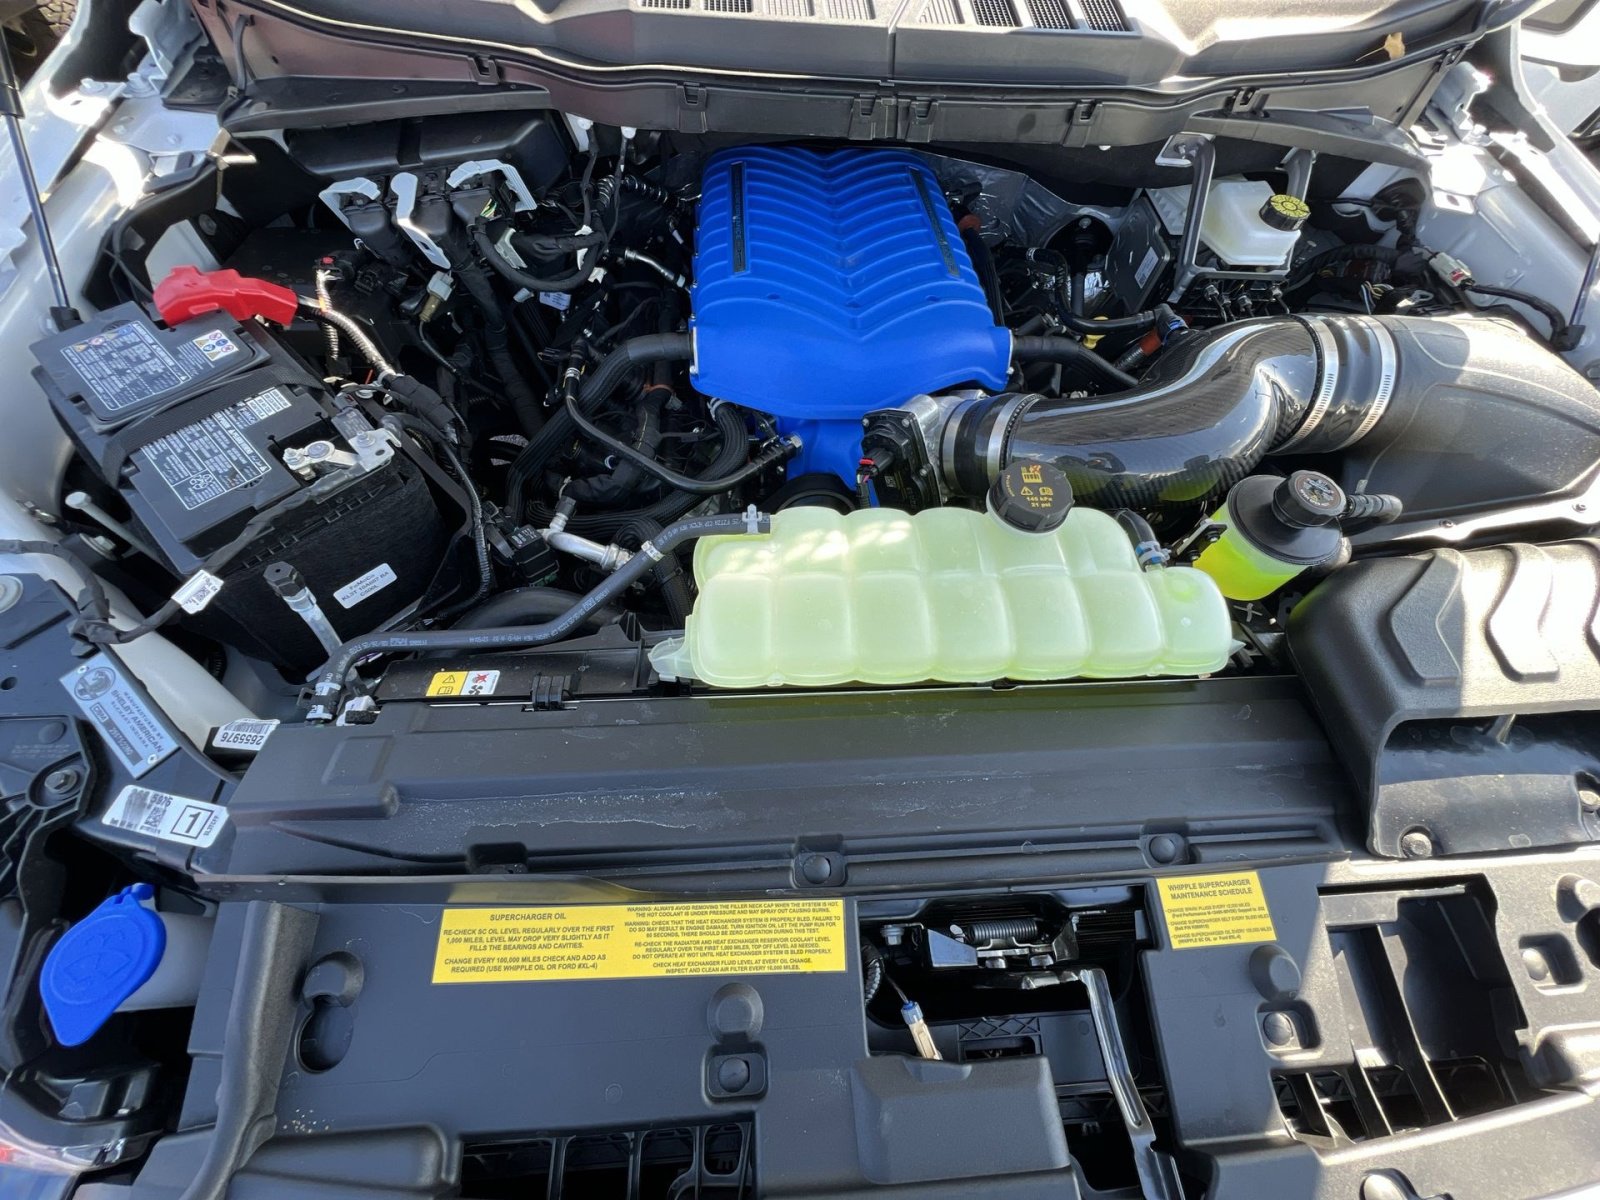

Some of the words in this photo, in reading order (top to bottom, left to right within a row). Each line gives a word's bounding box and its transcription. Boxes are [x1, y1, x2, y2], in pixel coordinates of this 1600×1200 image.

[122, 691, 157, 732] MANUFACTURED
[110, 688, 135, 717] SHELBY
[130, 714, 164, 753] AMERICAN
[220, 732, 264, 746] 2655976
[184, 811, 202, 834] 1
[1198, 878, 1250, 888] SUPERCHARGER
[1170, 890, 1217, 899] MAINTENANCE
[1217, 887, 1252, 895] SCHEDULE
[489, 912, 552, 921] SUPERCHARGER
